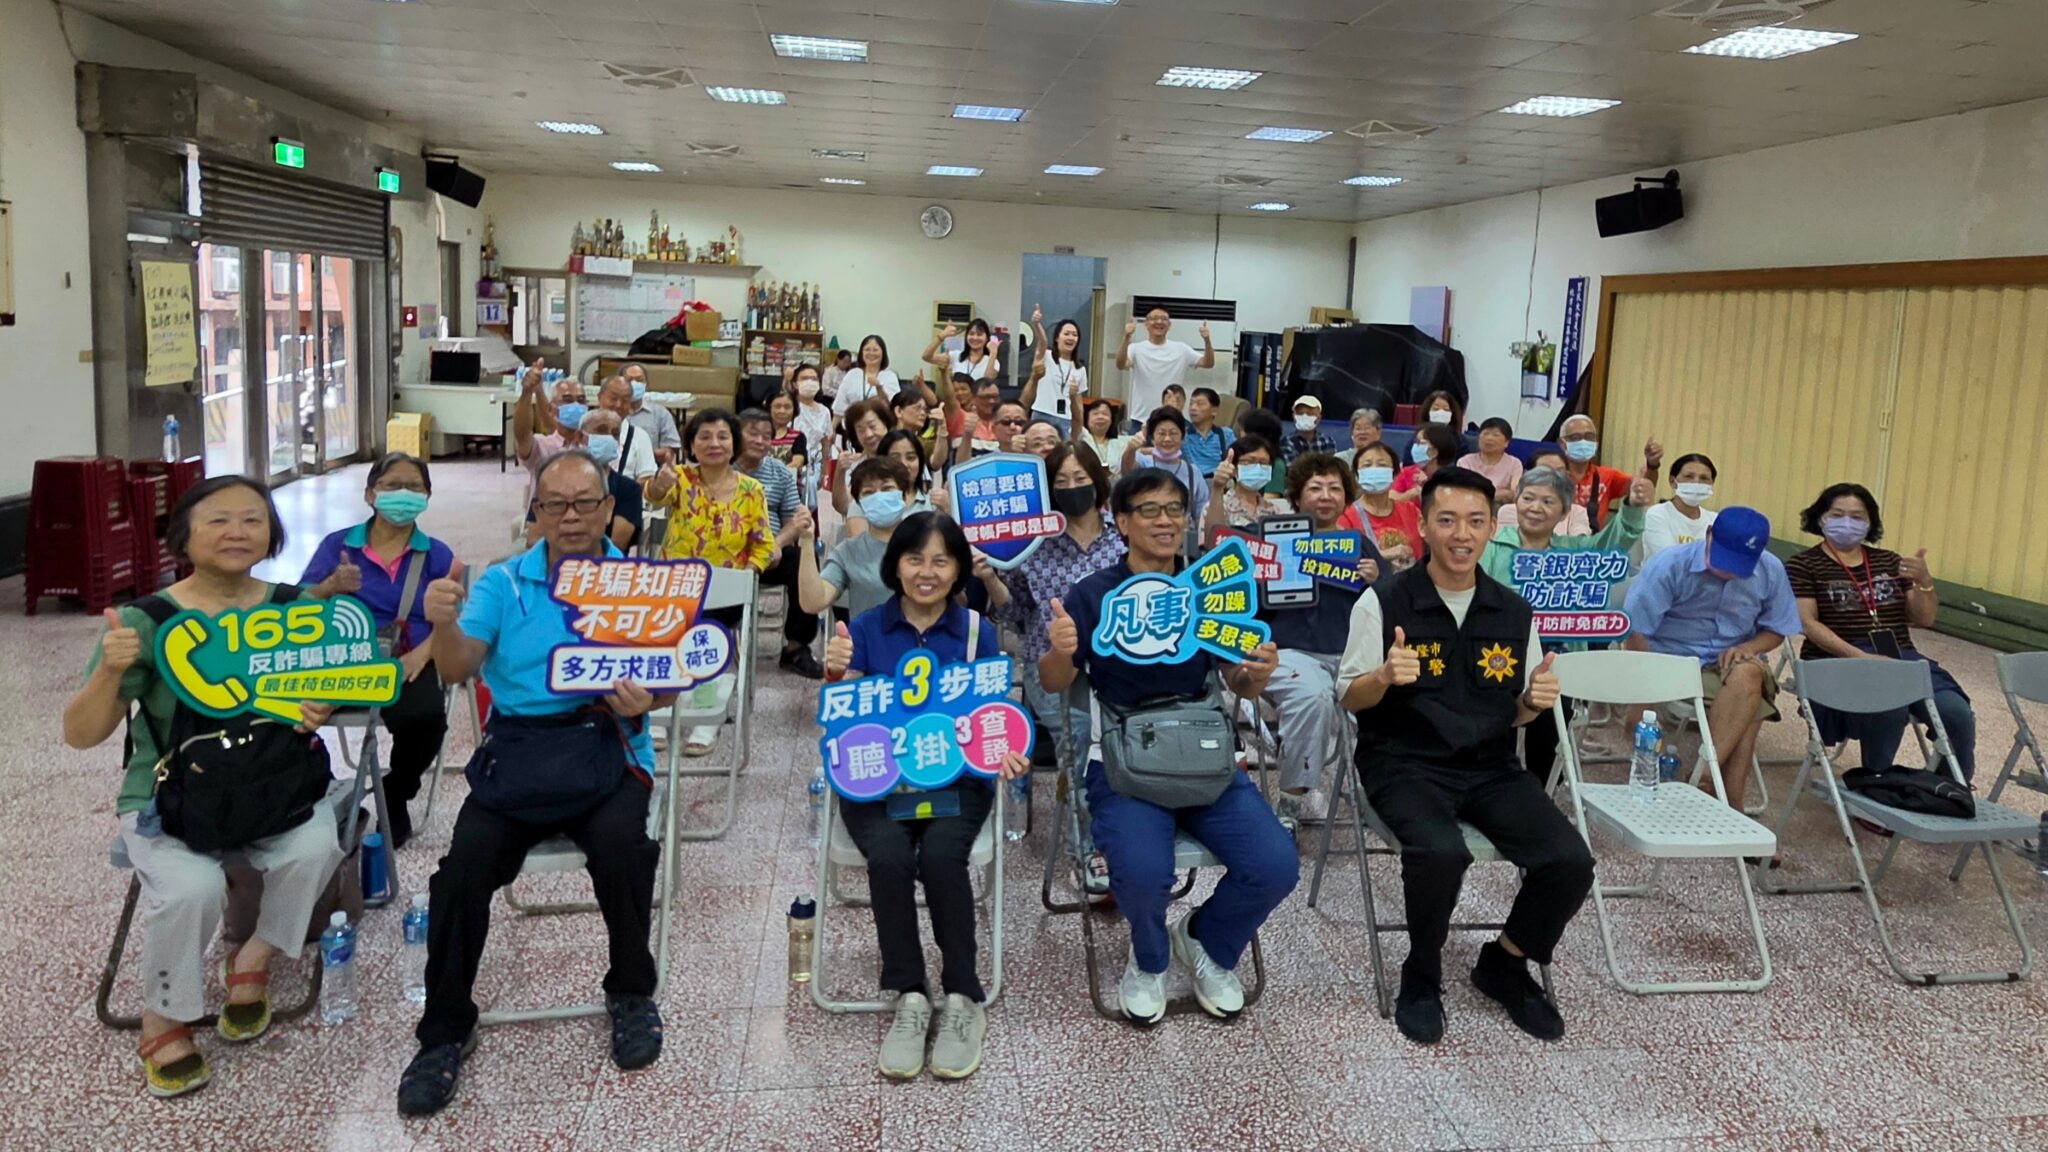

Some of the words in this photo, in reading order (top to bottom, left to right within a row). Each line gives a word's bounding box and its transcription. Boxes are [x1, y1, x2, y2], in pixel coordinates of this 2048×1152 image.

[485, 304, 500, 321] 17
[962, 472, 1035, 498] 檢警要錢
[973, 495, 1029, 518] 必詐騙
[1294, 538, 1354, 554] 勿信不明
[553, 559, 707, 599] 詐騙知識
[1199, 553, 1244, 586] 勿急
[1513, 551, 1629, 580] 警銀齊力
[1203, 590, 1246, 613] 勿躁
[1521, 581, 1609, 608] 防詐騙
[217, 604, 325, 653] 165
[572, 603, 685, 640] 不可少
[1101, 587, 1191, 643] 凡事
[692, 629, 709, 647] 保
[1196, 619, 1261, 652] 多思考
[247, 641, 373, 676] 反詐騙專線
[561, 654, 673, 682] 多方求證
[685, 647, 720, 669] 荷包
[262, 674, 390, 693] 最佳荷包防守員
